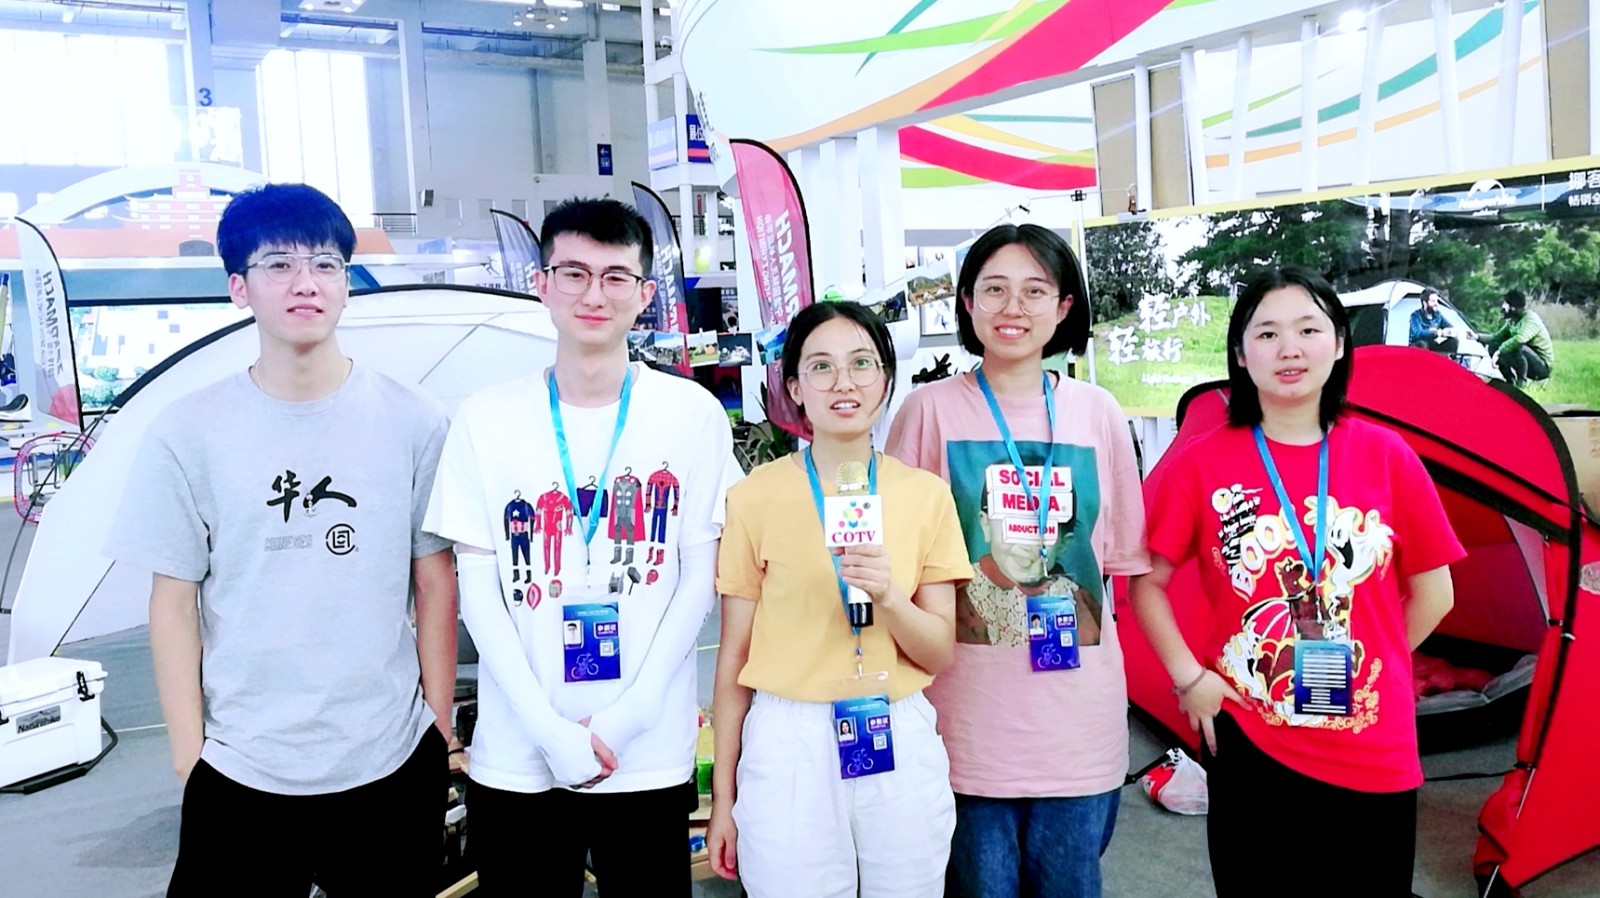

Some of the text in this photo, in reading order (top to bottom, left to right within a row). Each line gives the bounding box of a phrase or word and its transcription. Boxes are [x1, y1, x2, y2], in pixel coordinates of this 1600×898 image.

[199, 87, 212, 107] 3
[1138, 292, 1211, 334] 轻户外
[999, 469, 1065, 487] SOCIL
[266, 469, 357, 523] 华人
[1002, 493, 1060, 512] MEDA
[832, 530, 876, 544] COTV
[1008, 523, 1055, 535] ABDUCTON
